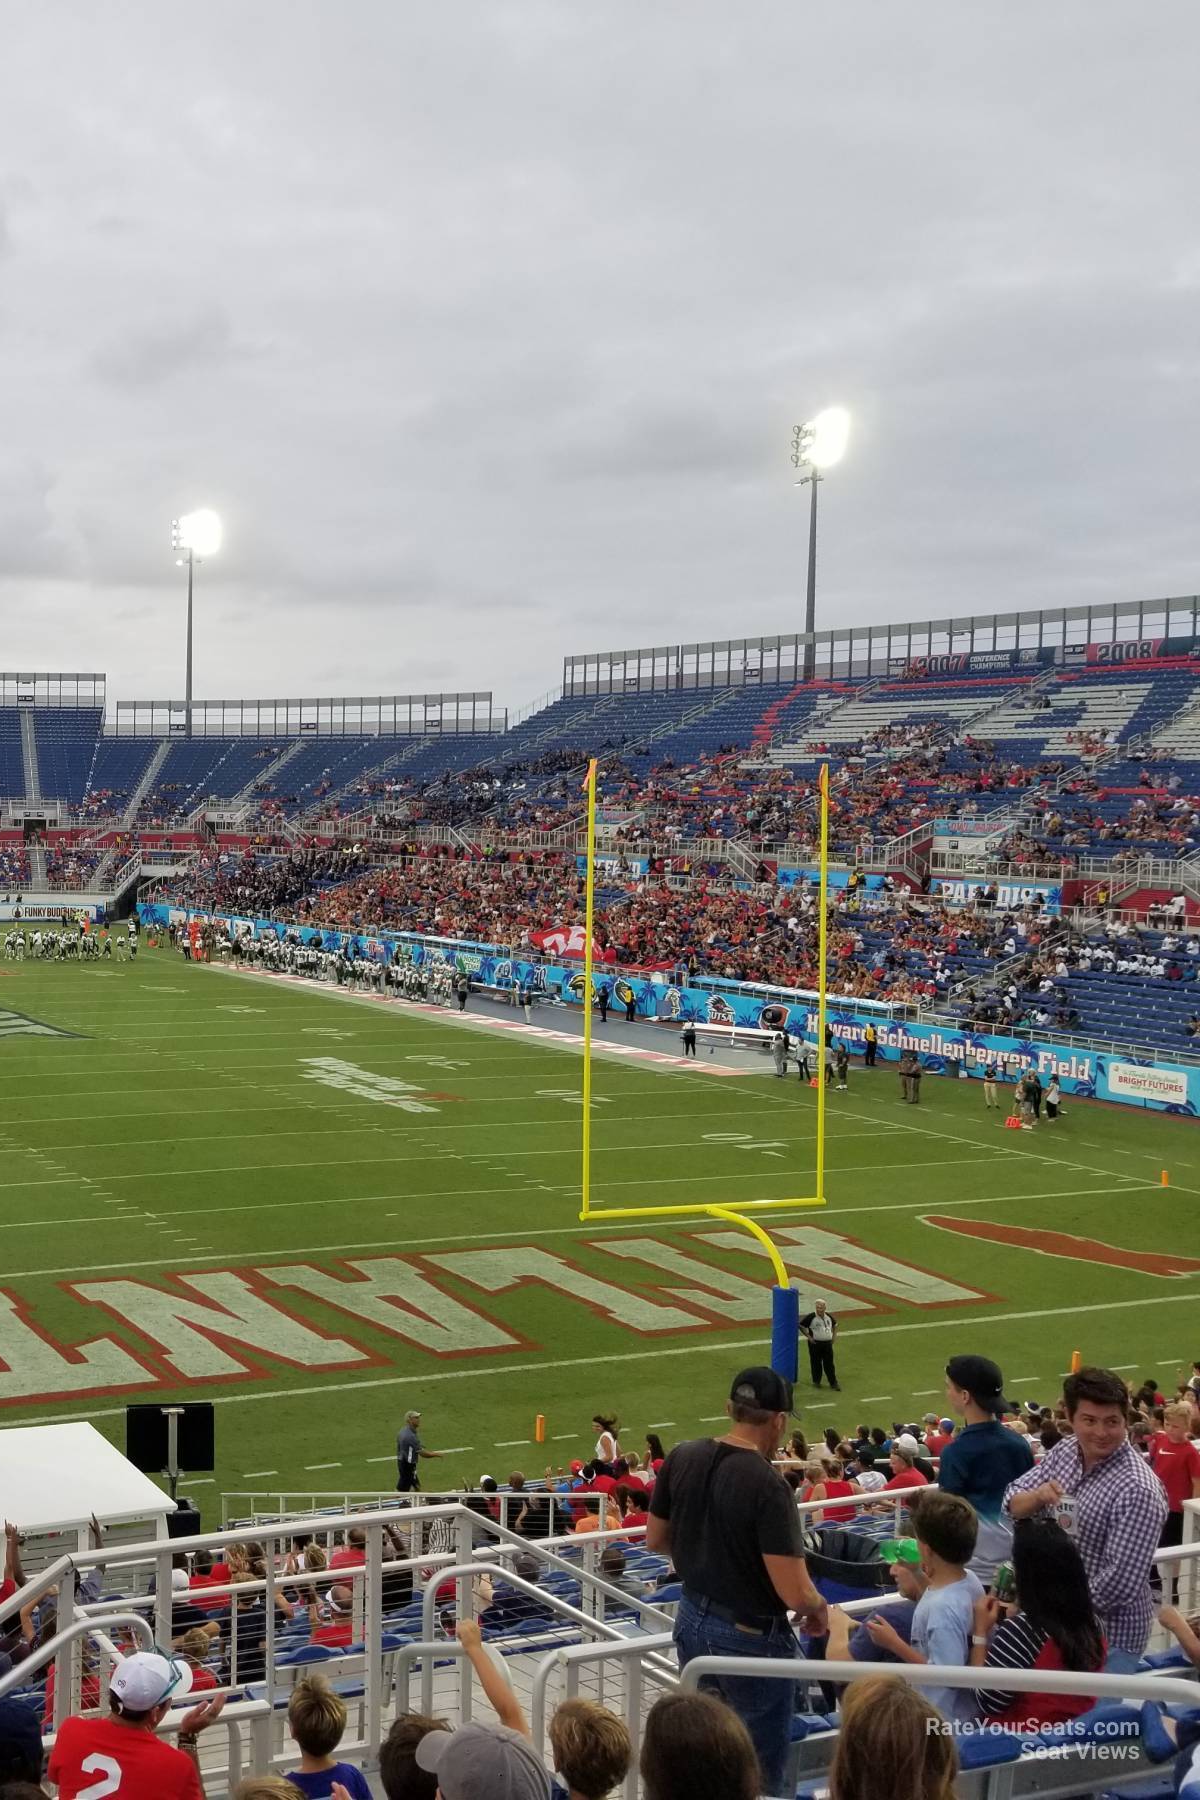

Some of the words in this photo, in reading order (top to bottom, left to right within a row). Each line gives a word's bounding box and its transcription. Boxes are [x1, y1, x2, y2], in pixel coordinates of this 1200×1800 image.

[969, 653, 1010, 663] CONFERENCE
[1097, 641, 1153, 661] 2008
[916, 654, 966, 674] 2007
[969, 661, 1010, 671] CHAMPIONS
[24, 906, 46, 917] FUNKY
[710, 1011, 733, 1022] UTSA
[806, 1013, 869, 1042] Hward
[1037, 1051, 1091, 1081] Field
[1118, 1075, 1148, 1088] BRIGHT
[1148, 1080, 1184, 1093] FUTURES
[75, 1752, 122, 1800] 2
